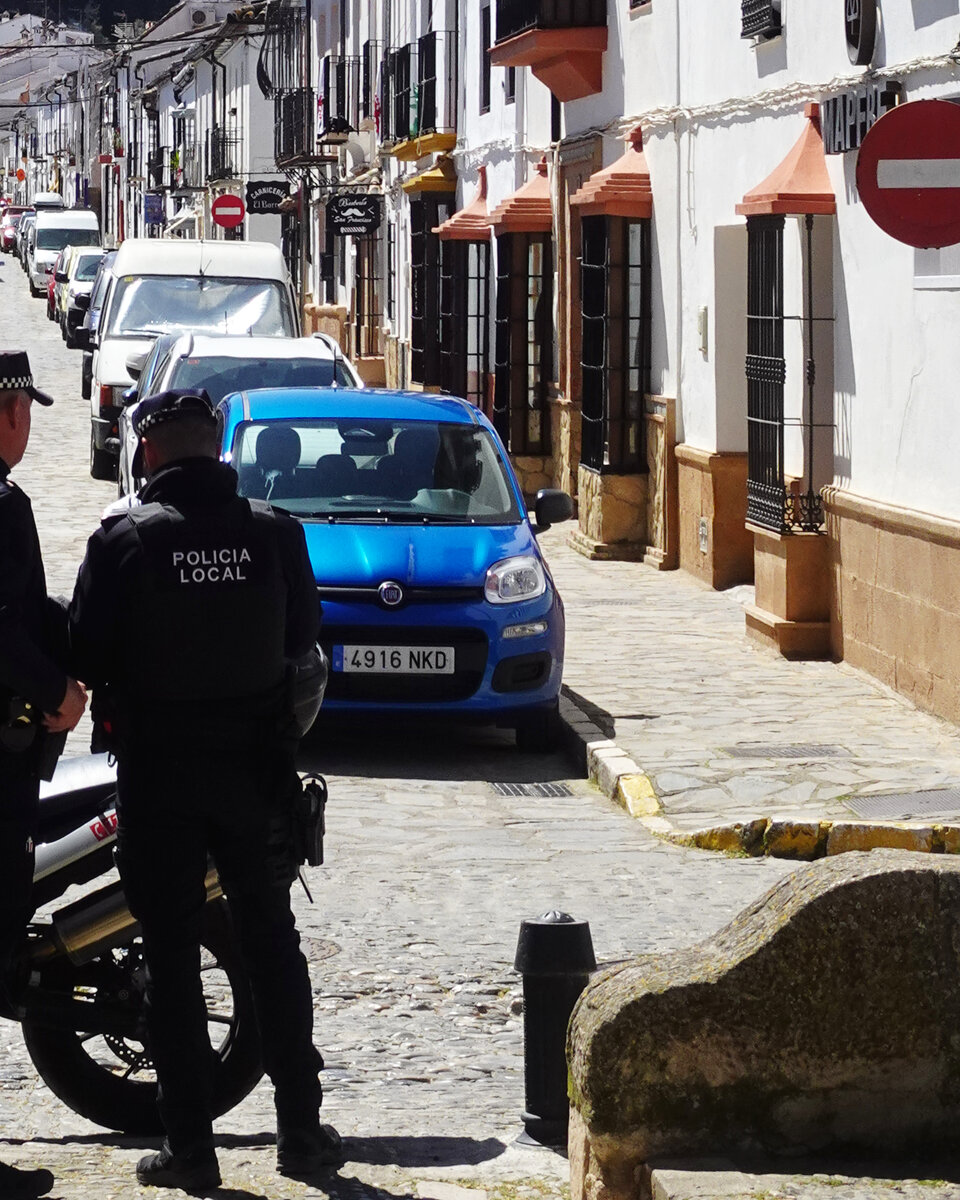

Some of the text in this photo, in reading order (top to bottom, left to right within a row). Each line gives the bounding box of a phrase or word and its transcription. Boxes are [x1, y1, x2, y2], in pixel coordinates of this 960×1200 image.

[261, 200, 278, 209] Borr
[172, 548, 252, 567] POLICIA
[180, 565, 247, 583] LOCAL
[350, 649, 447, 670] 4916 NKD
